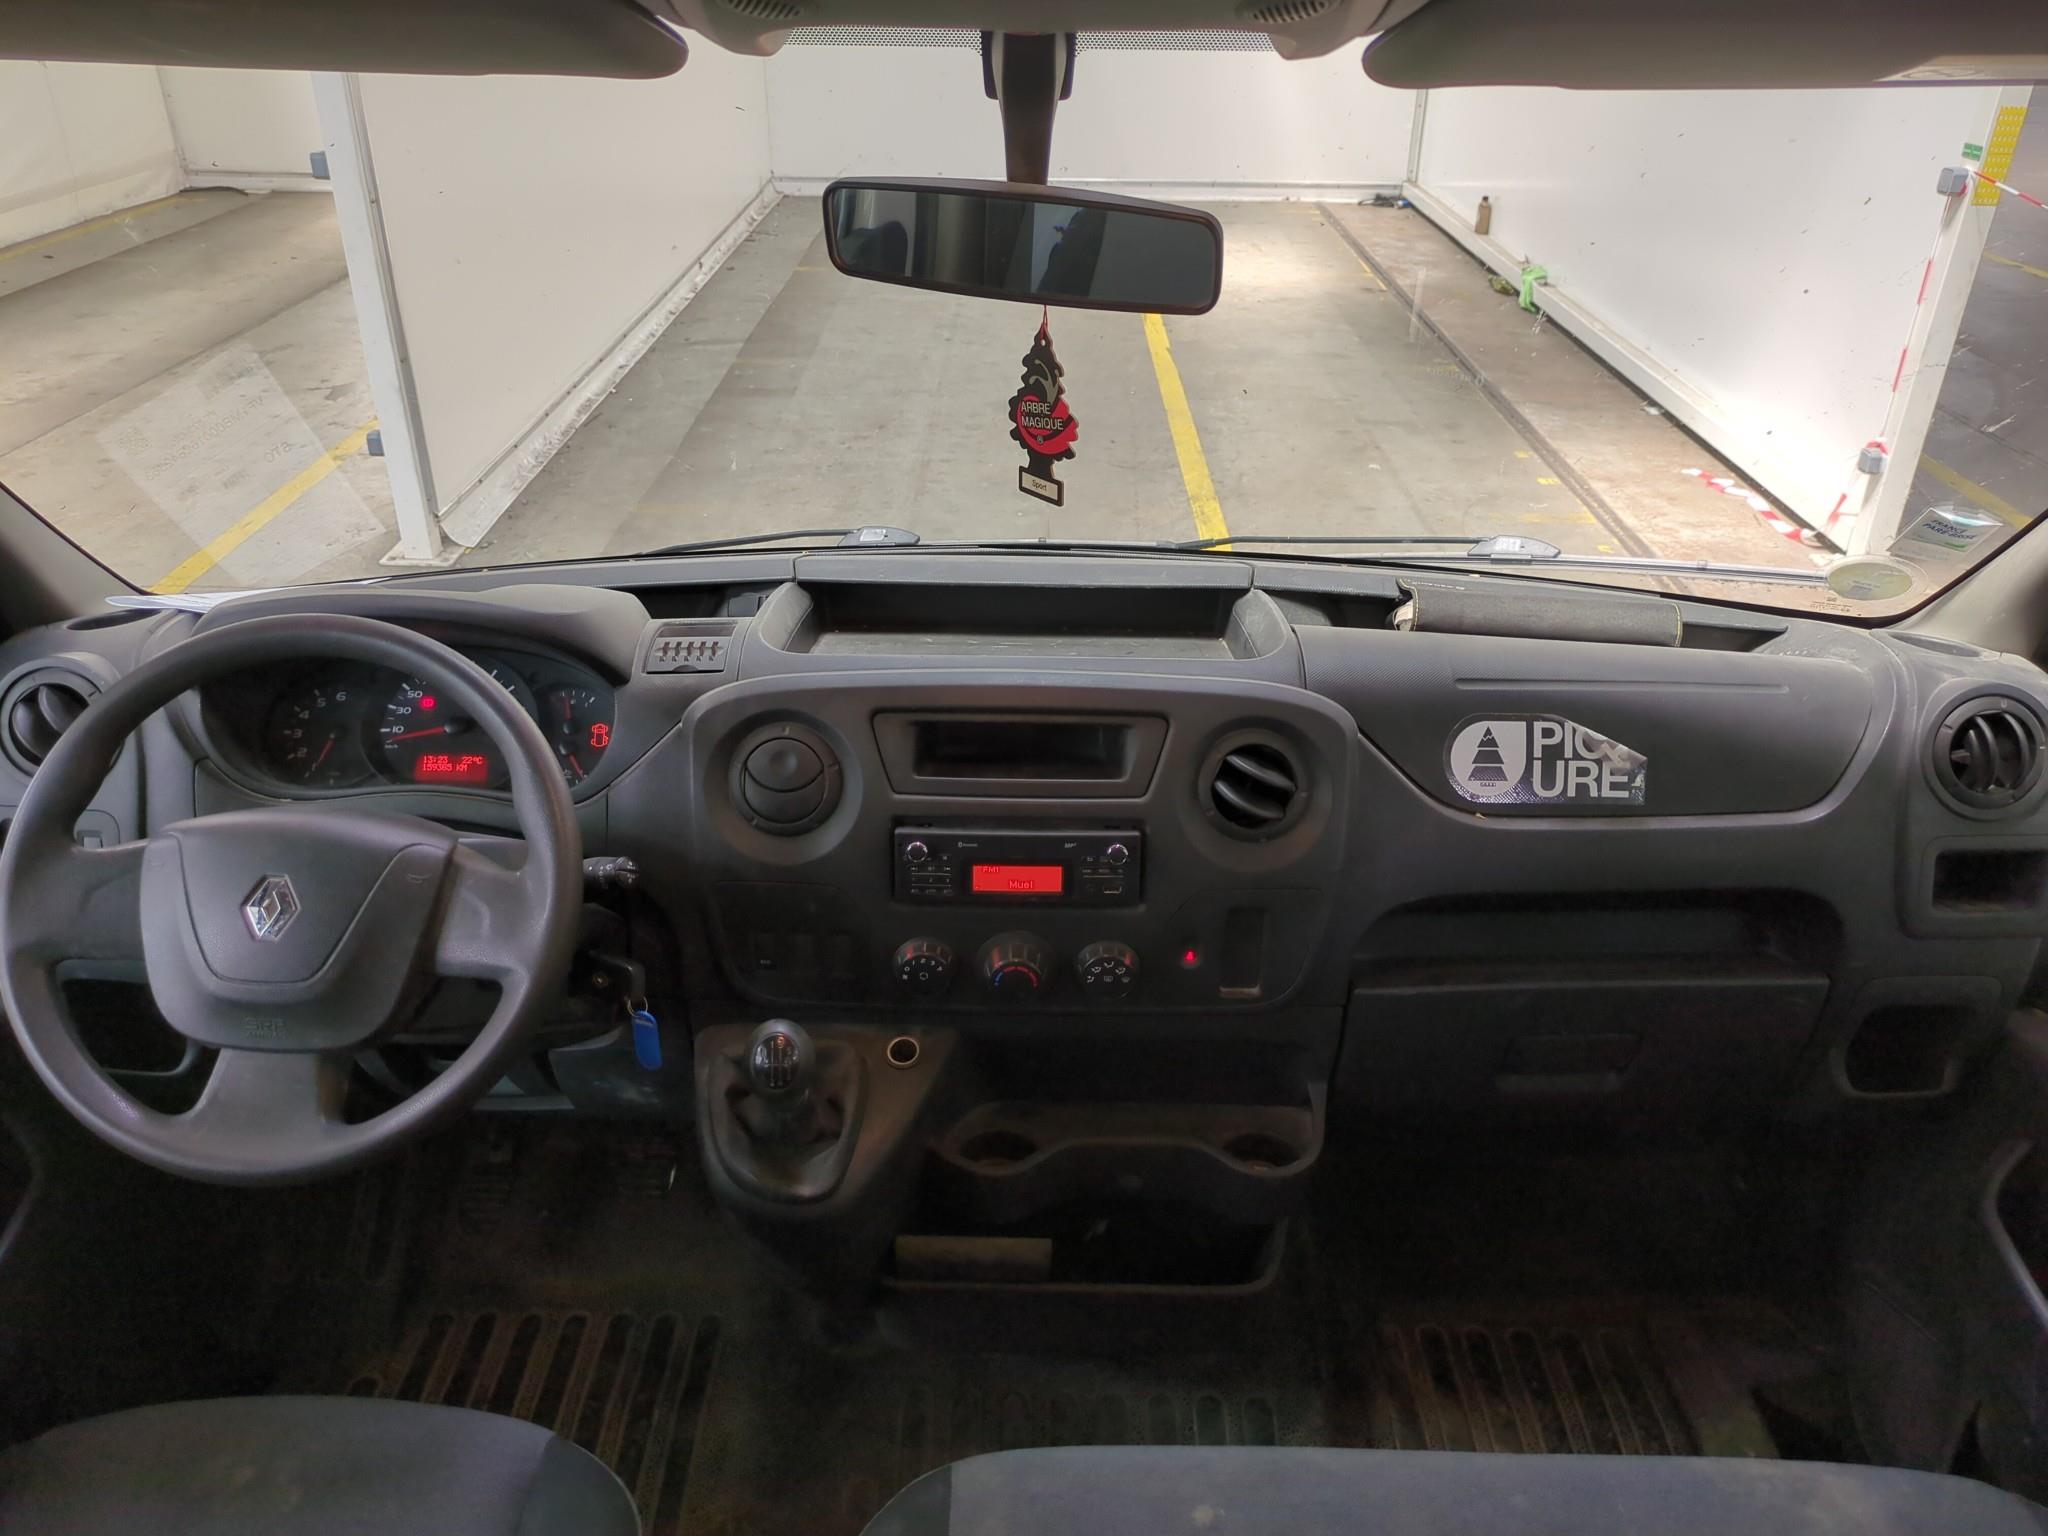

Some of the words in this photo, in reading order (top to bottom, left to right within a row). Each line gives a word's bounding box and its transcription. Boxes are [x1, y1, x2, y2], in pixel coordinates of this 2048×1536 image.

[1021, 401, 1052, 415] ARBRE
[1021, 414, 1064, 431] MAGIQUE
[1032, 479, 1047, 492] Sport
[336, 691, 346, 702] 6
[407, 690, 423, 699] 50
[396, 706, 412, 715] 30
[392, 725, 405, 734] 10
[423, 755, 448, 764] 13:23
[455, 764, 468, 772] KM
[1533, 759, 1630, 798] URE
